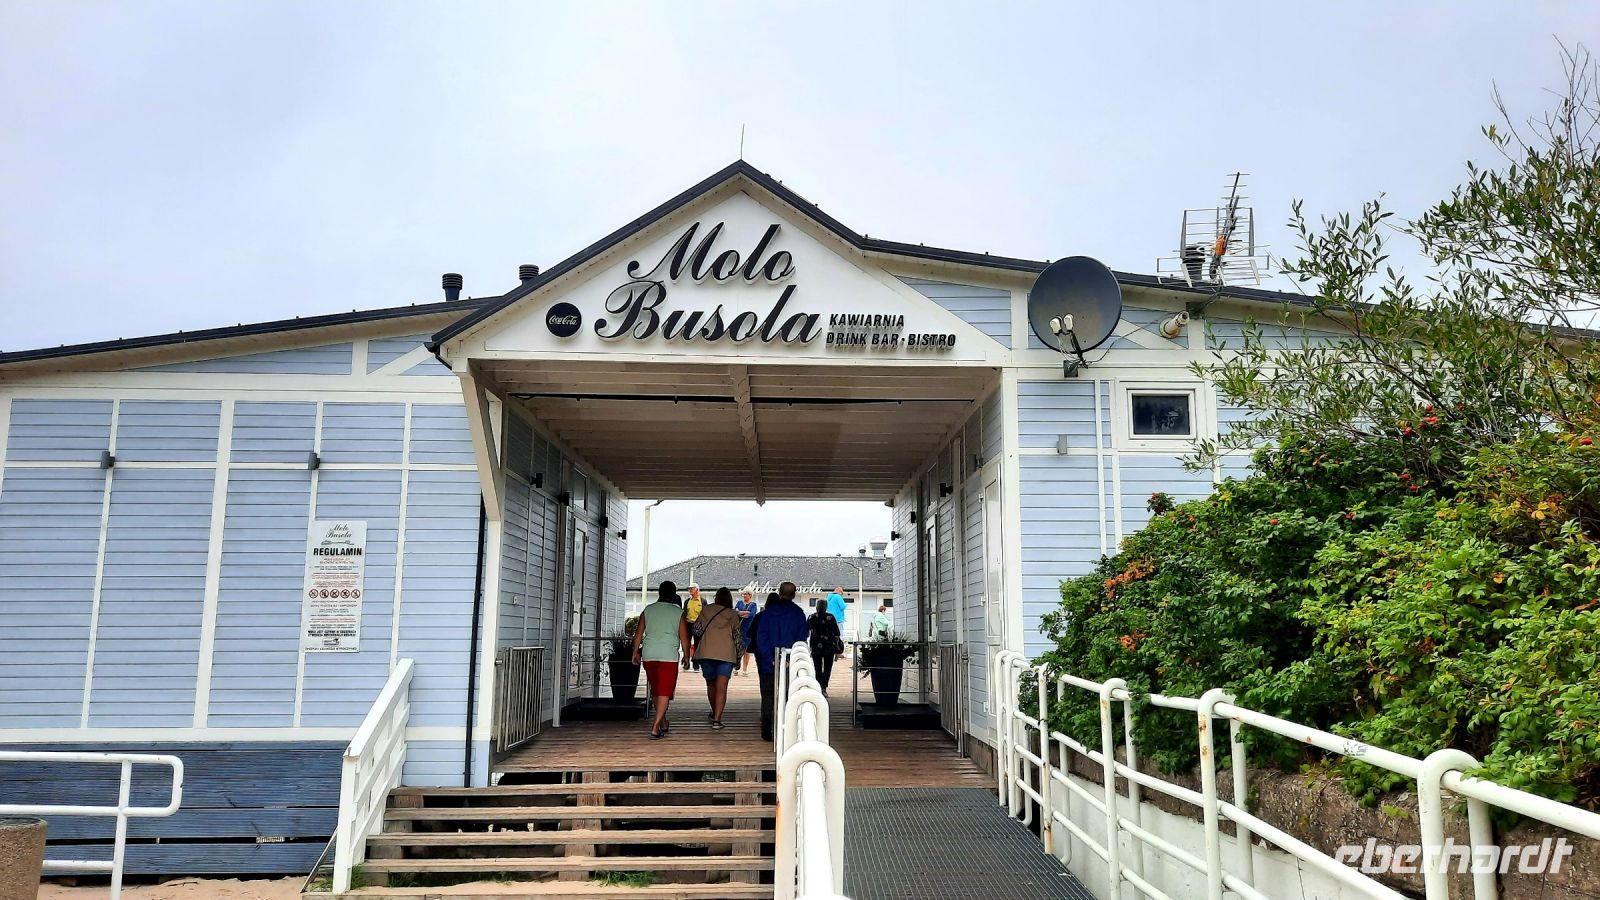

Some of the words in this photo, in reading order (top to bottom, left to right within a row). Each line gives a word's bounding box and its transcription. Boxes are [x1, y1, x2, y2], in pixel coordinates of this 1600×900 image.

[627, 221, 797, 282] Molo
[594, 280, 822, 343] Busola
[829, 313, 905, 327] KAWIARNIA
[826, 332, 867, 346] DRINK
[907, 333, 957, 347] BISTRO
[326, 530, 352, 538] Busola
[313, 547, 363, 556] REGULAMIN
